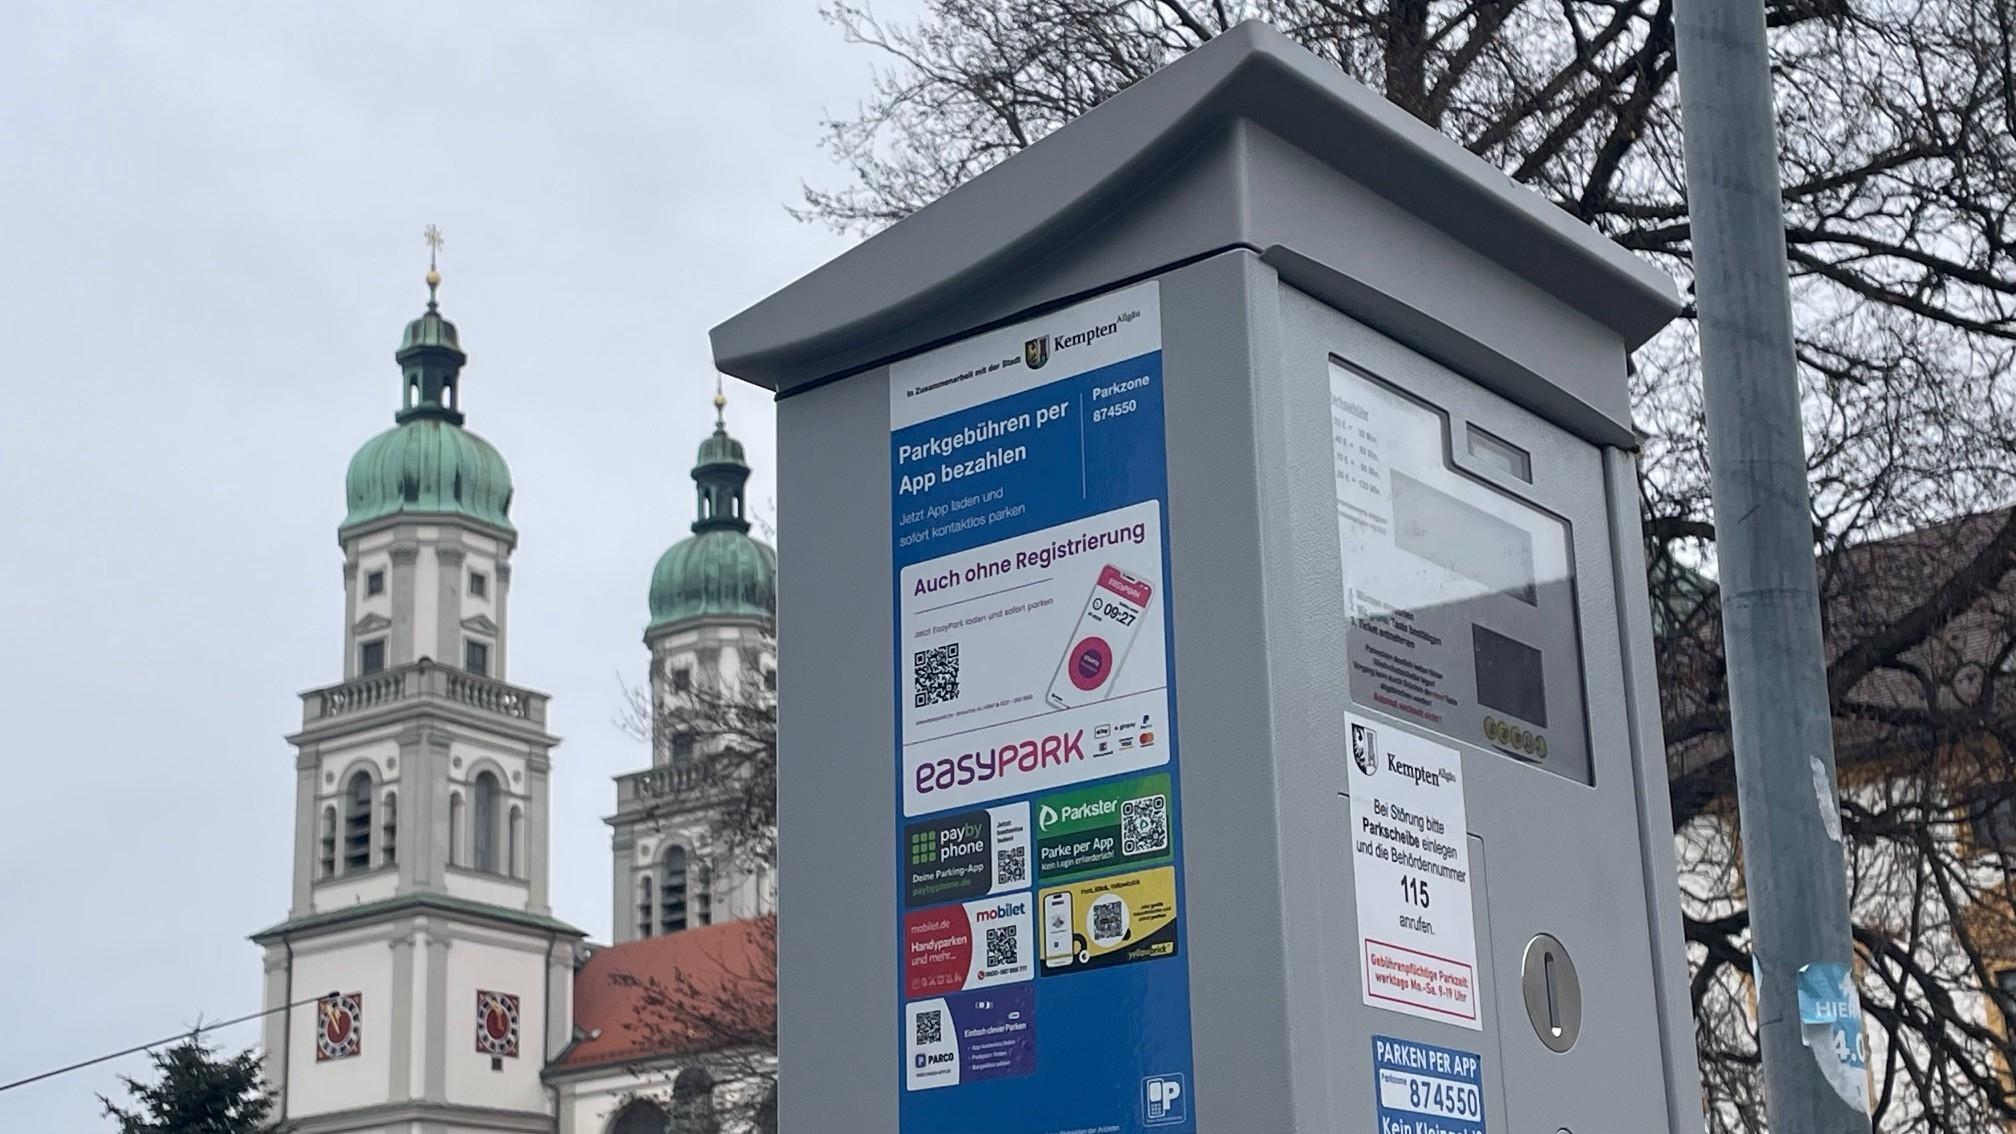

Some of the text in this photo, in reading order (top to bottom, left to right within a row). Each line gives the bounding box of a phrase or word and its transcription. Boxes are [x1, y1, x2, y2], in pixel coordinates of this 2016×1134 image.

[1054, 322, 1117, 351] Kempten
[915, 371, 973, 395] Zusammenarbeit
[975, 367, 987, 377] mit
[988, 363, 1000, 372] der
[1002, 356, 1021, 368] Stadt
[1092, 375, 1150, 401] Parkzone
[1093, 399, 1136, 422] 874550
[899, 401, 1069, 465] Parkgebühren per
[899, 445, 1026, 496] App bezahlen
[899, 486, 1004, 526] Jetzt App laden und
[899, 503, 1026, 547] sofort kontaktlos parken
[913, 522, 1146, 597] Auch ohne Registrierung
[988, 609, 1003, 620] und
[1004, 604, 1026, 616] sofort
[1027, 598, 1054, 613] parken
[1103, 603, 1137, 627] 09:27
[1386, 752, 1440, 787] Kempten
[1061, 799, 1118, 822] Parkster
[1374, 798, 1445, 835] Bei Störung bitte
[1041, 837, 1114, 860] Parke per App
[1362, 816, 1458, 860] Parkscheibe einlegen
[940, 840, 984, 863] phone
[1056, 859, 1074, 869] Login
[1356, 839, 1467, 883] und die Behördennummer
[912, 863, 985, 884] Deine Parking-App
[1400, 874, 1430, 909] 115
[976, 902, 1026, 923] mobilet
[1399, 914, 1436, 936] anrufen.
[911, 920, 951, 934] mobilet.de
[911, 935, 968, 953] Handyparken
[911, 953, 928, 966] und
[1375, 971, 1409, 991] werktags
[1454, 989, 1467, 1003] Uhr
[928, 1052, 954, 1065] PARCO
[1376, 1040, 1477, 1079] PARKEN PER APP
[1410, 1079, 1478, 1118] 874550
[1382, 1116, 1412, 1134] Kein
